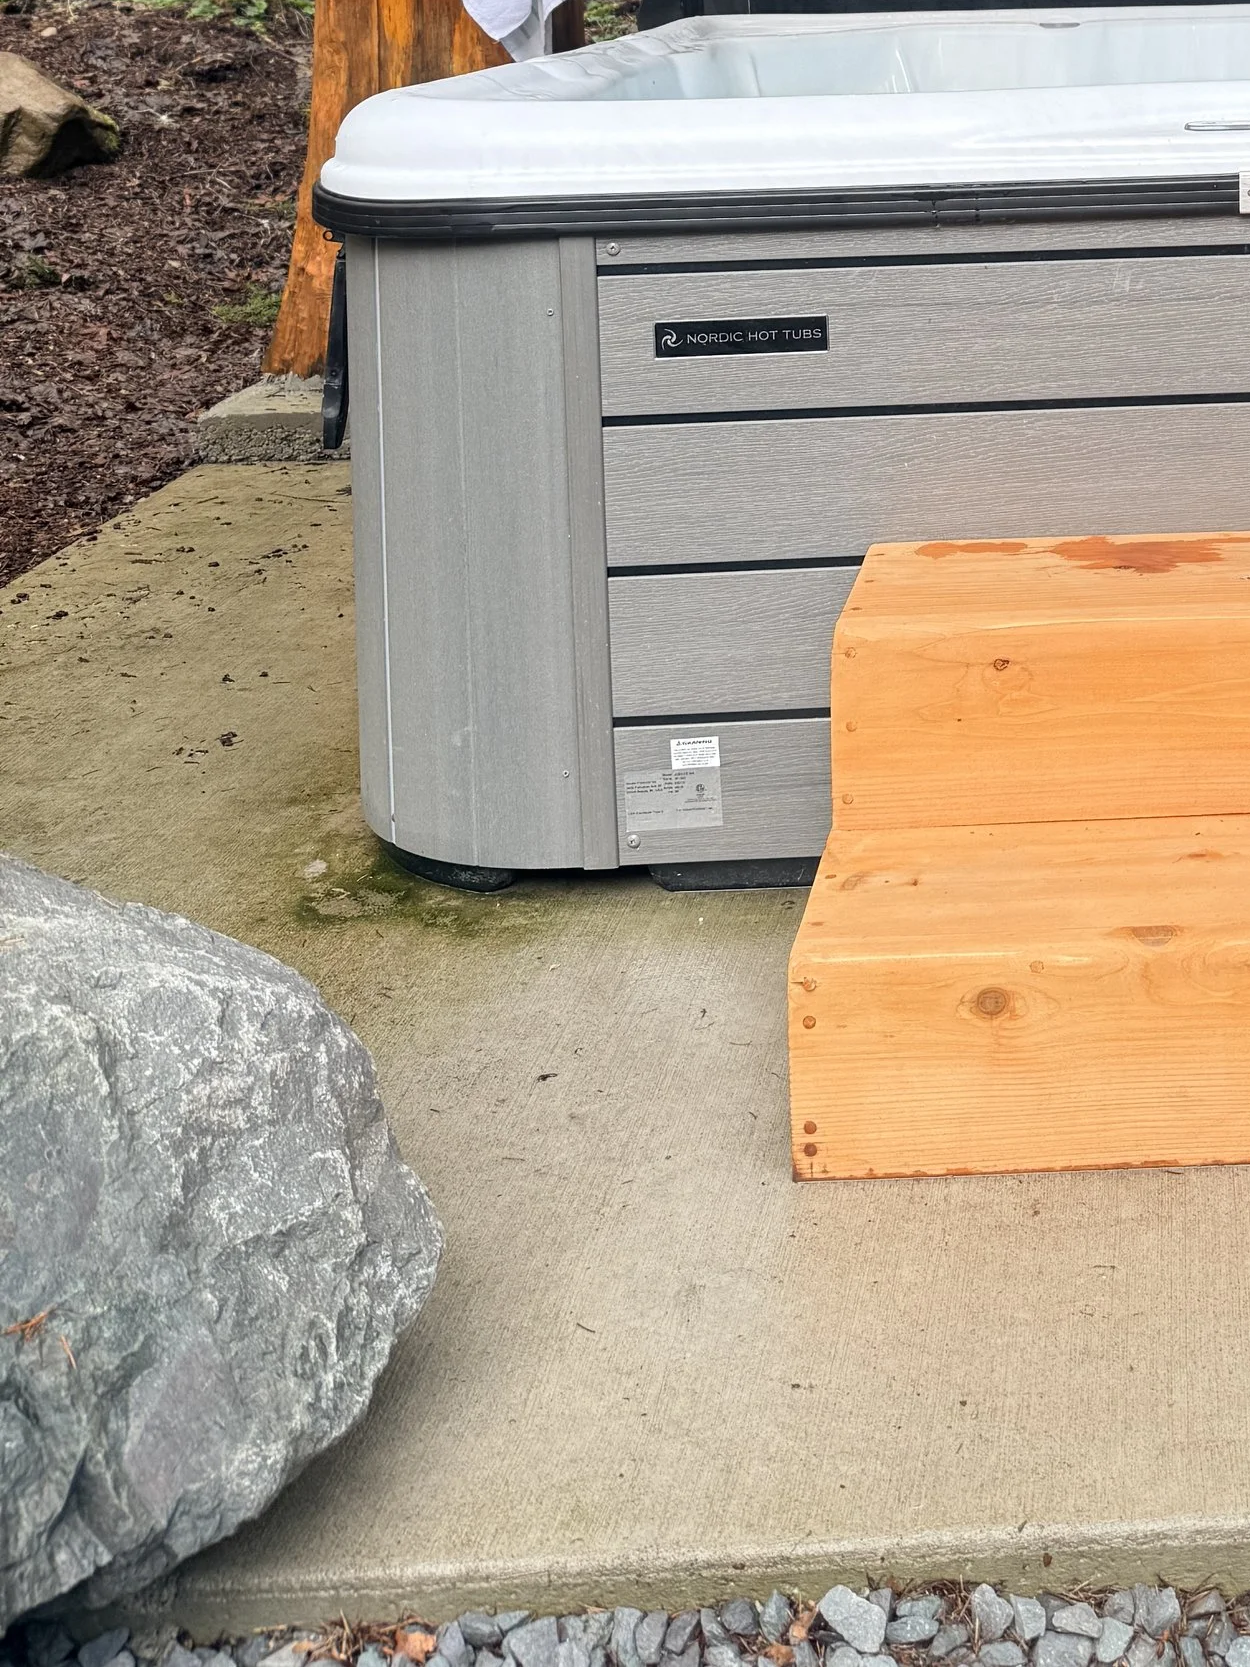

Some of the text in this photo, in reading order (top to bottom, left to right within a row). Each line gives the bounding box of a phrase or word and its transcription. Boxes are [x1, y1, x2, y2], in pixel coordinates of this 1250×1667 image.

[687, 329, 822, 344] NORDIC HOT TUBS
